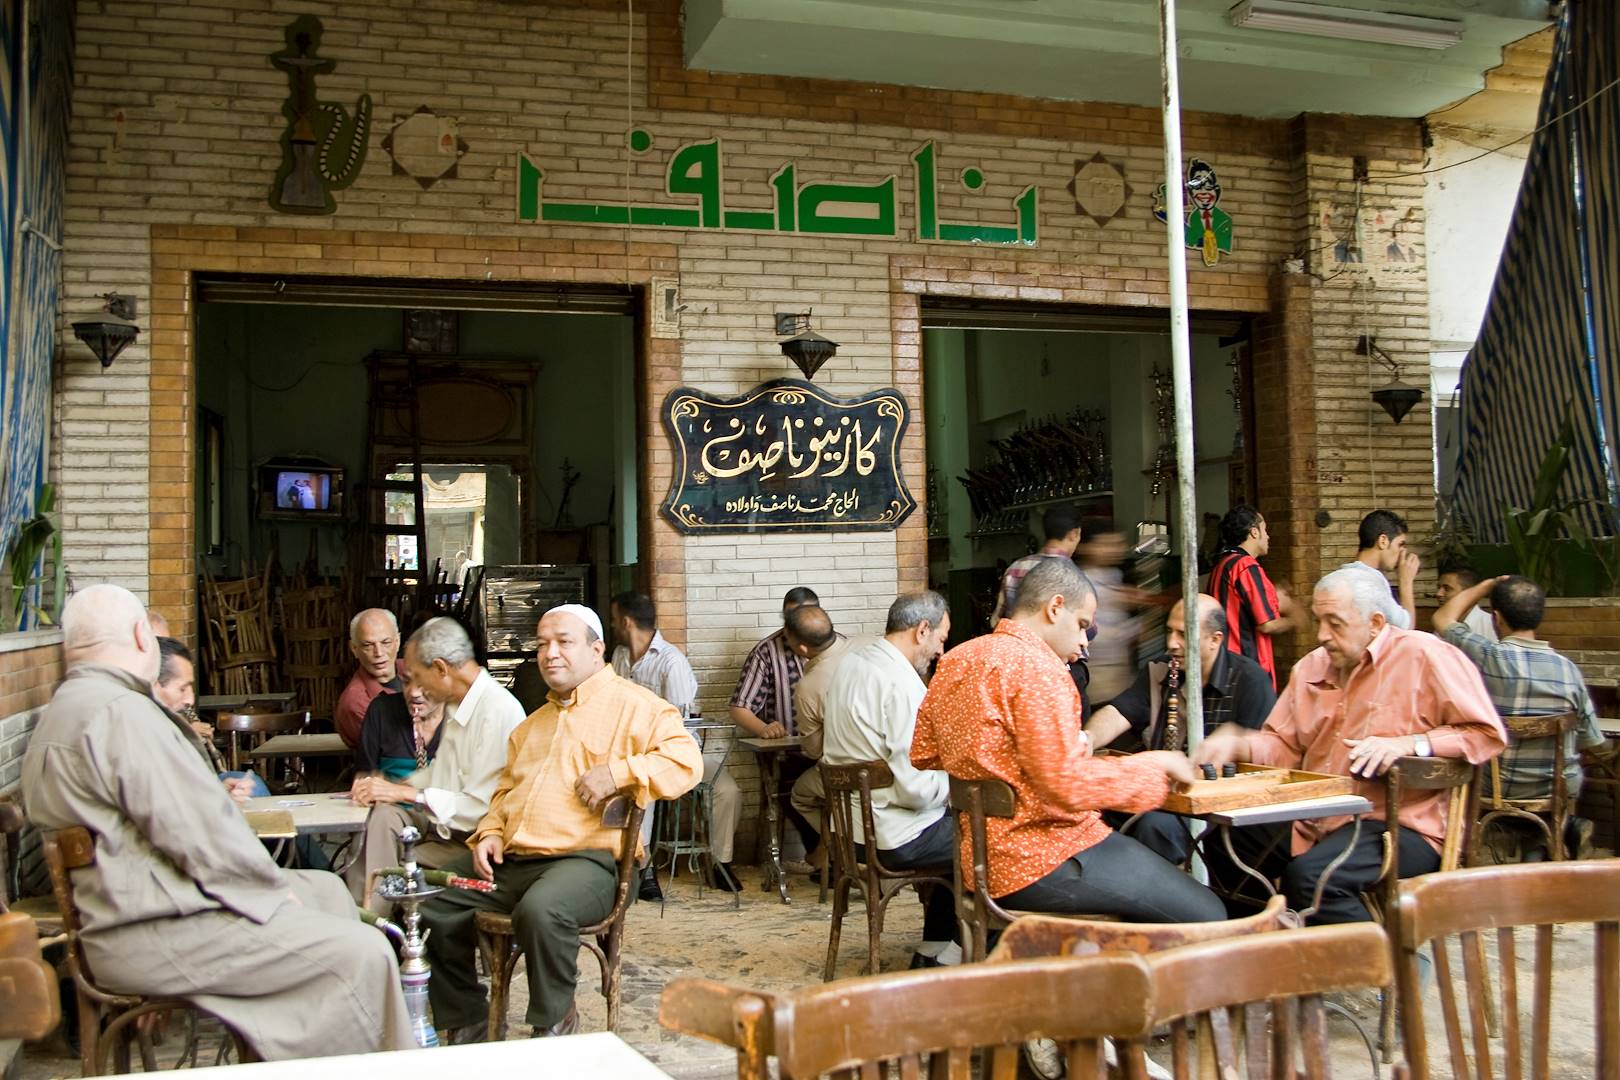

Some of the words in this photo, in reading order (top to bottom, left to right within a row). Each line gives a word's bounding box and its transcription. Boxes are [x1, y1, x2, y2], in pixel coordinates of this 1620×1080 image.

[518, 129, 1037, 246] ناصف
[788, 416, 881, 478] كازينو
[760, 494, 797, 512] ناصف
[833, 488, 859, 517] الحاج
